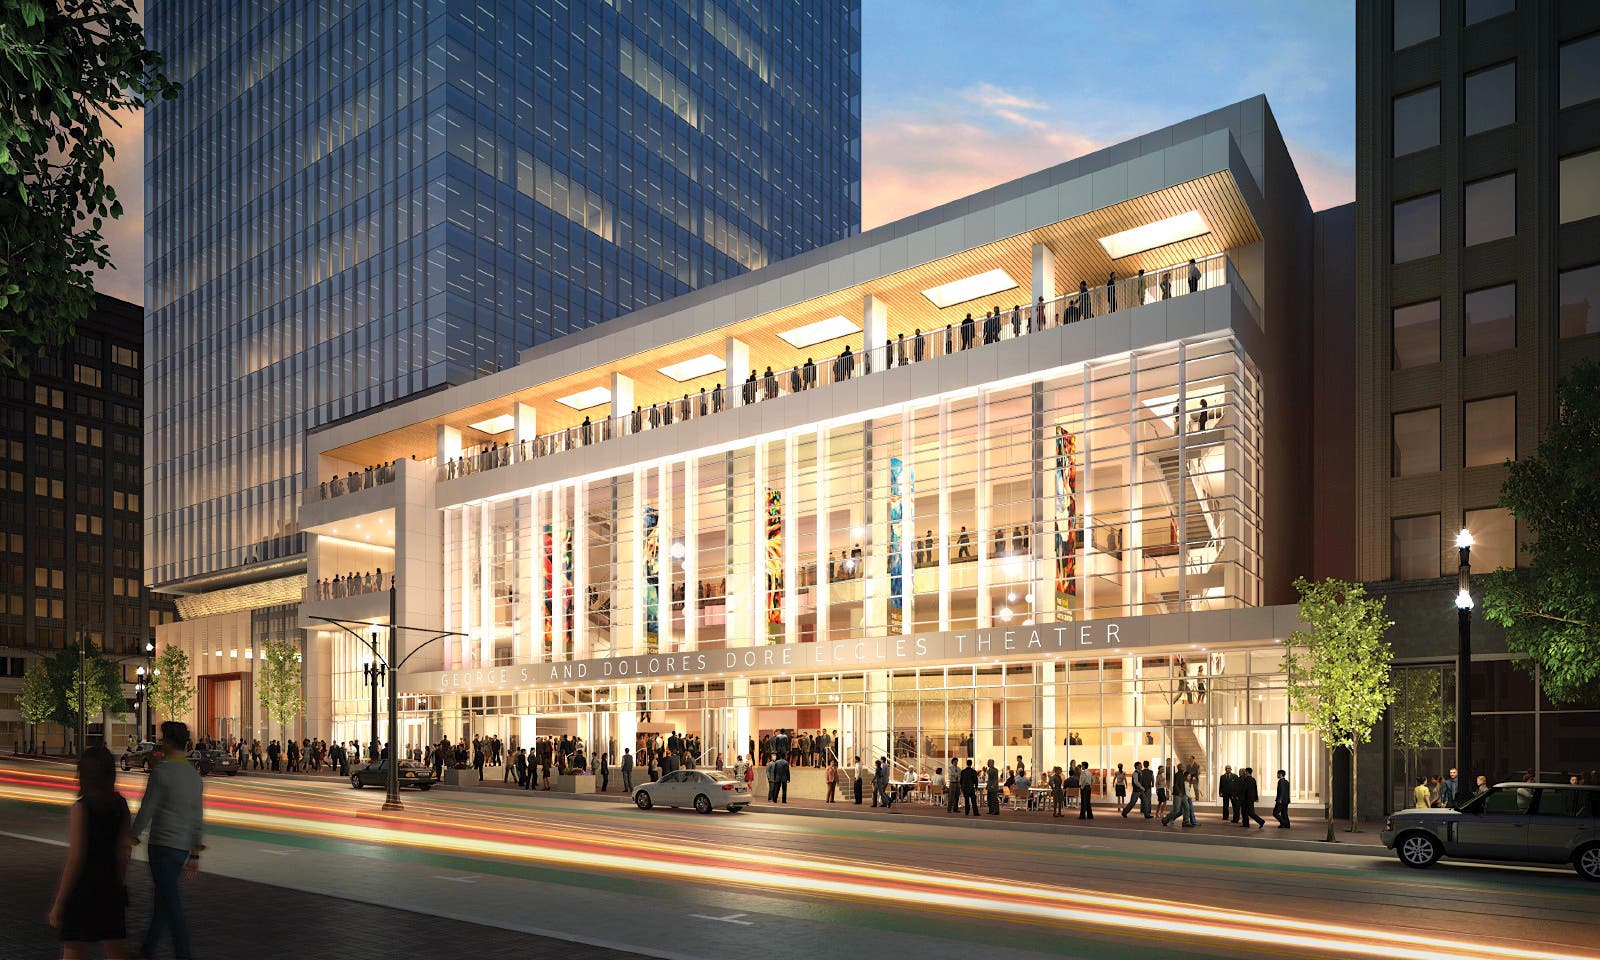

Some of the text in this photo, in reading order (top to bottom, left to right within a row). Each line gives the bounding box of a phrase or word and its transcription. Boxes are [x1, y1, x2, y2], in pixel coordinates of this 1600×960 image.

[441, 623, 1121, 687] GEORGE S. AND DOLORES DORE ECCLES THEATER
